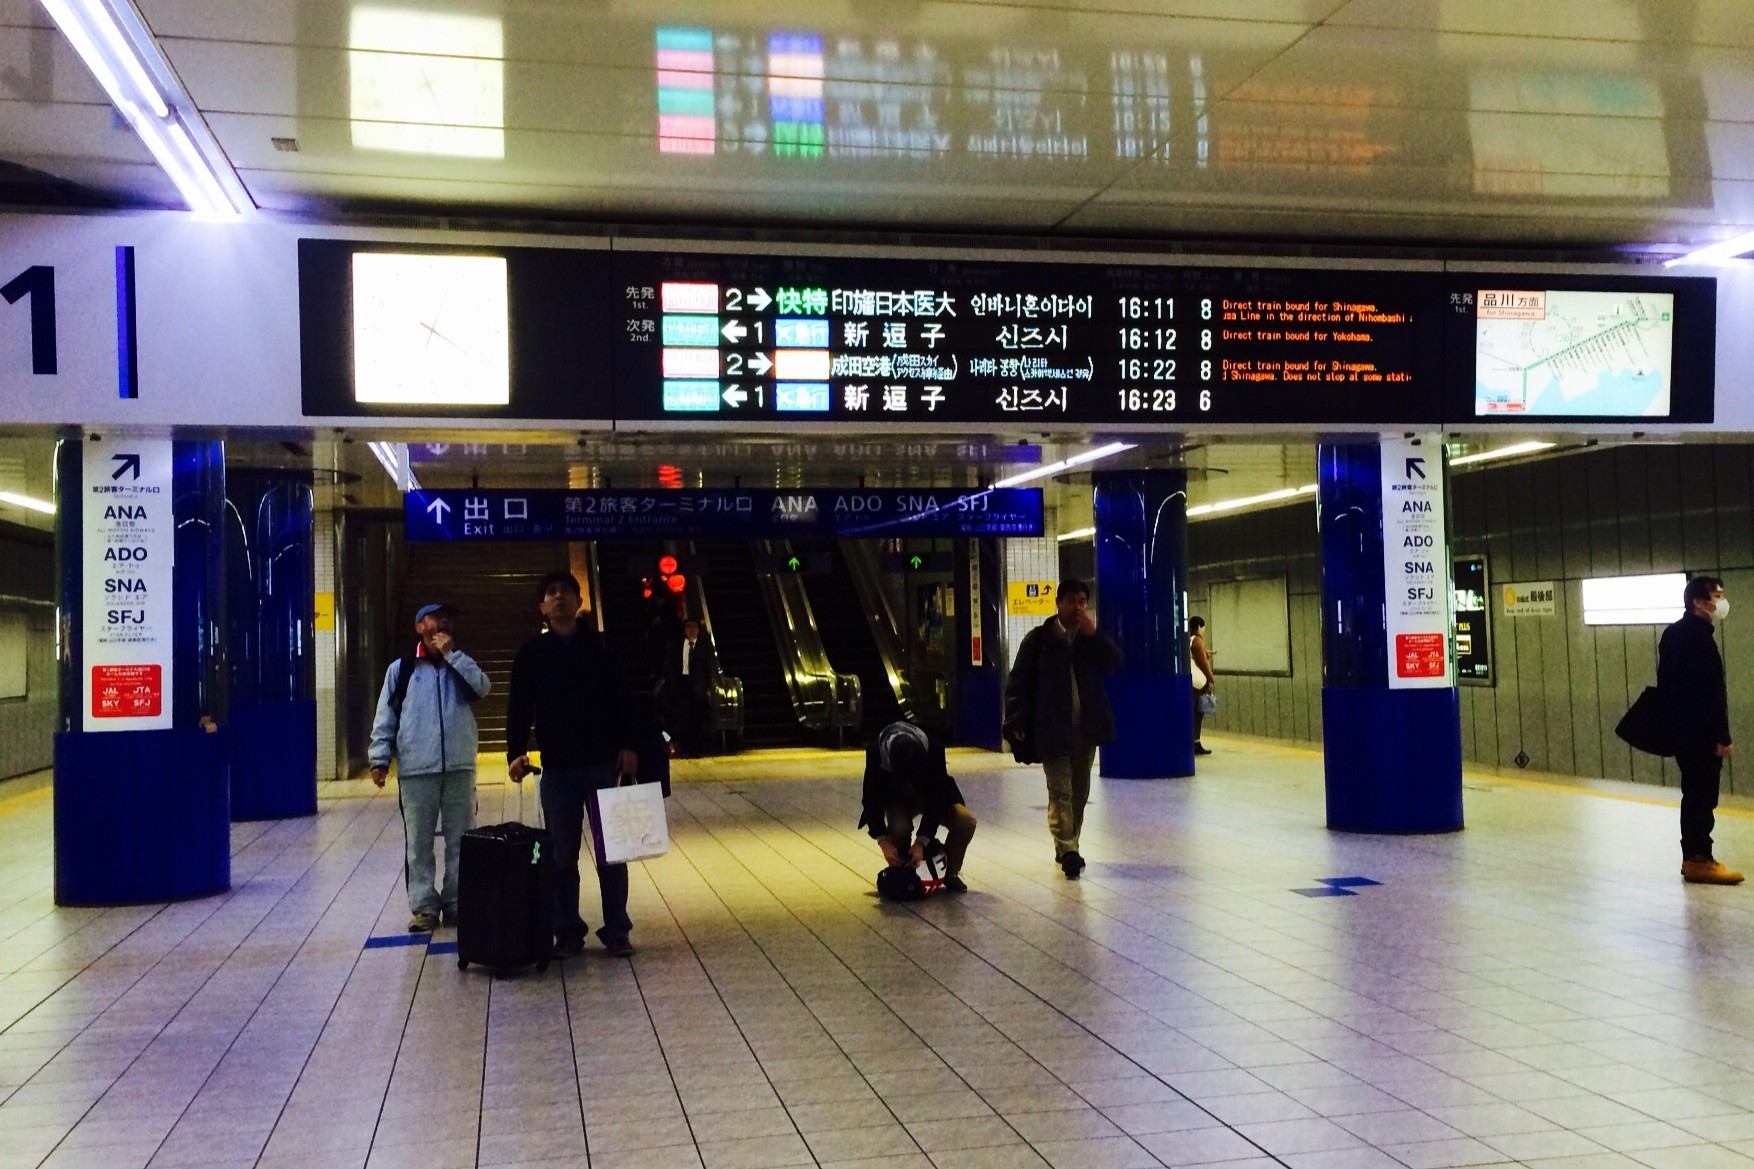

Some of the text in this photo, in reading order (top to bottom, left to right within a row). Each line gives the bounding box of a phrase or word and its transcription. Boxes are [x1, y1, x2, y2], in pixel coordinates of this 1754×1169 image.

[626, 286, 655, 299] 先発
[1450, 292, 1474, 304] 先発
[726, 288, 743, 311] 2
[775, 287, 829, 315] 快特
[831, 288, 957, 317] 印旛日本医大
[970, 292, 1093, 319] 인바니혼이다이
[1223, 300, 1253, 310] Direct
[1257, 301, 1281, 311] train
[1285, 301, 1309, 311] bound
[1315, 301, 1328, 311] for
[1483, 293, 1539, 307] 品川 方面
[1119, 297, 1212, 320] 16:11 8
[0, 265, 57, 375] 1
[1240, 311, 1260, 320] Line
[1280, 312, 1293, 321] the
[1298, 312, 1341, 322] direction
[626, 319, 655, 332] 次発
[754, 321, 764, 344] 1
[843, 321, 946, 349] 新逗子
[995, 324, 1068, 351] 신즈시
[1119, 328, 1212, 351] 16:12 8
[1223, 329, 1253, 340] Direct
[1257, 331, 1281, 340] train
[1285, 331, 1309, 341] bound
[1314, 331, 1328, 341] for
[726, 353, 743, 376] 2
[831, 353, 892, 378] 成田空港
[1119, 359, 1176, 380] 16:22
[1201, 360, 1212, 381] 8
[1222, 360, 1252, 370] Direct
[1257, 361, 1281, 370] train
[1284, 361, 1309, 371] bound
[1314, 361, 1327, 371] for
[1283, 370, 1303, 381] Does
[1307, 372, 1321, 381] not
[754, 385, 764, 408] 1
[844, 384, 946, 411] 新逗子
[995, 386, 1068, 412] 신즈시
[1118, 389, 1211, 411] 16:23 6
[464, 496, 528, 520] 出口
[564, 496, 752, 514] 第2旅客ターミナル口
[771, 495, 988, 513] ANA ADO SNA SFJ
[1402, 501, 1432, 513] ANA
[104, 505, 147, 519] ANA
[464, 523, 494, 535] Exit
[1403, 535, 1433, 547] ADO
[104, 547, 148, 562] ADO
[1404, 561, 1434, 574] SNA
[104, 578, 147, 593] SNA
[1407, 587, 1434, 600] SFJ
[107, 610, 145, 624] SFJ
[102, 687, 119, 695] JAL
